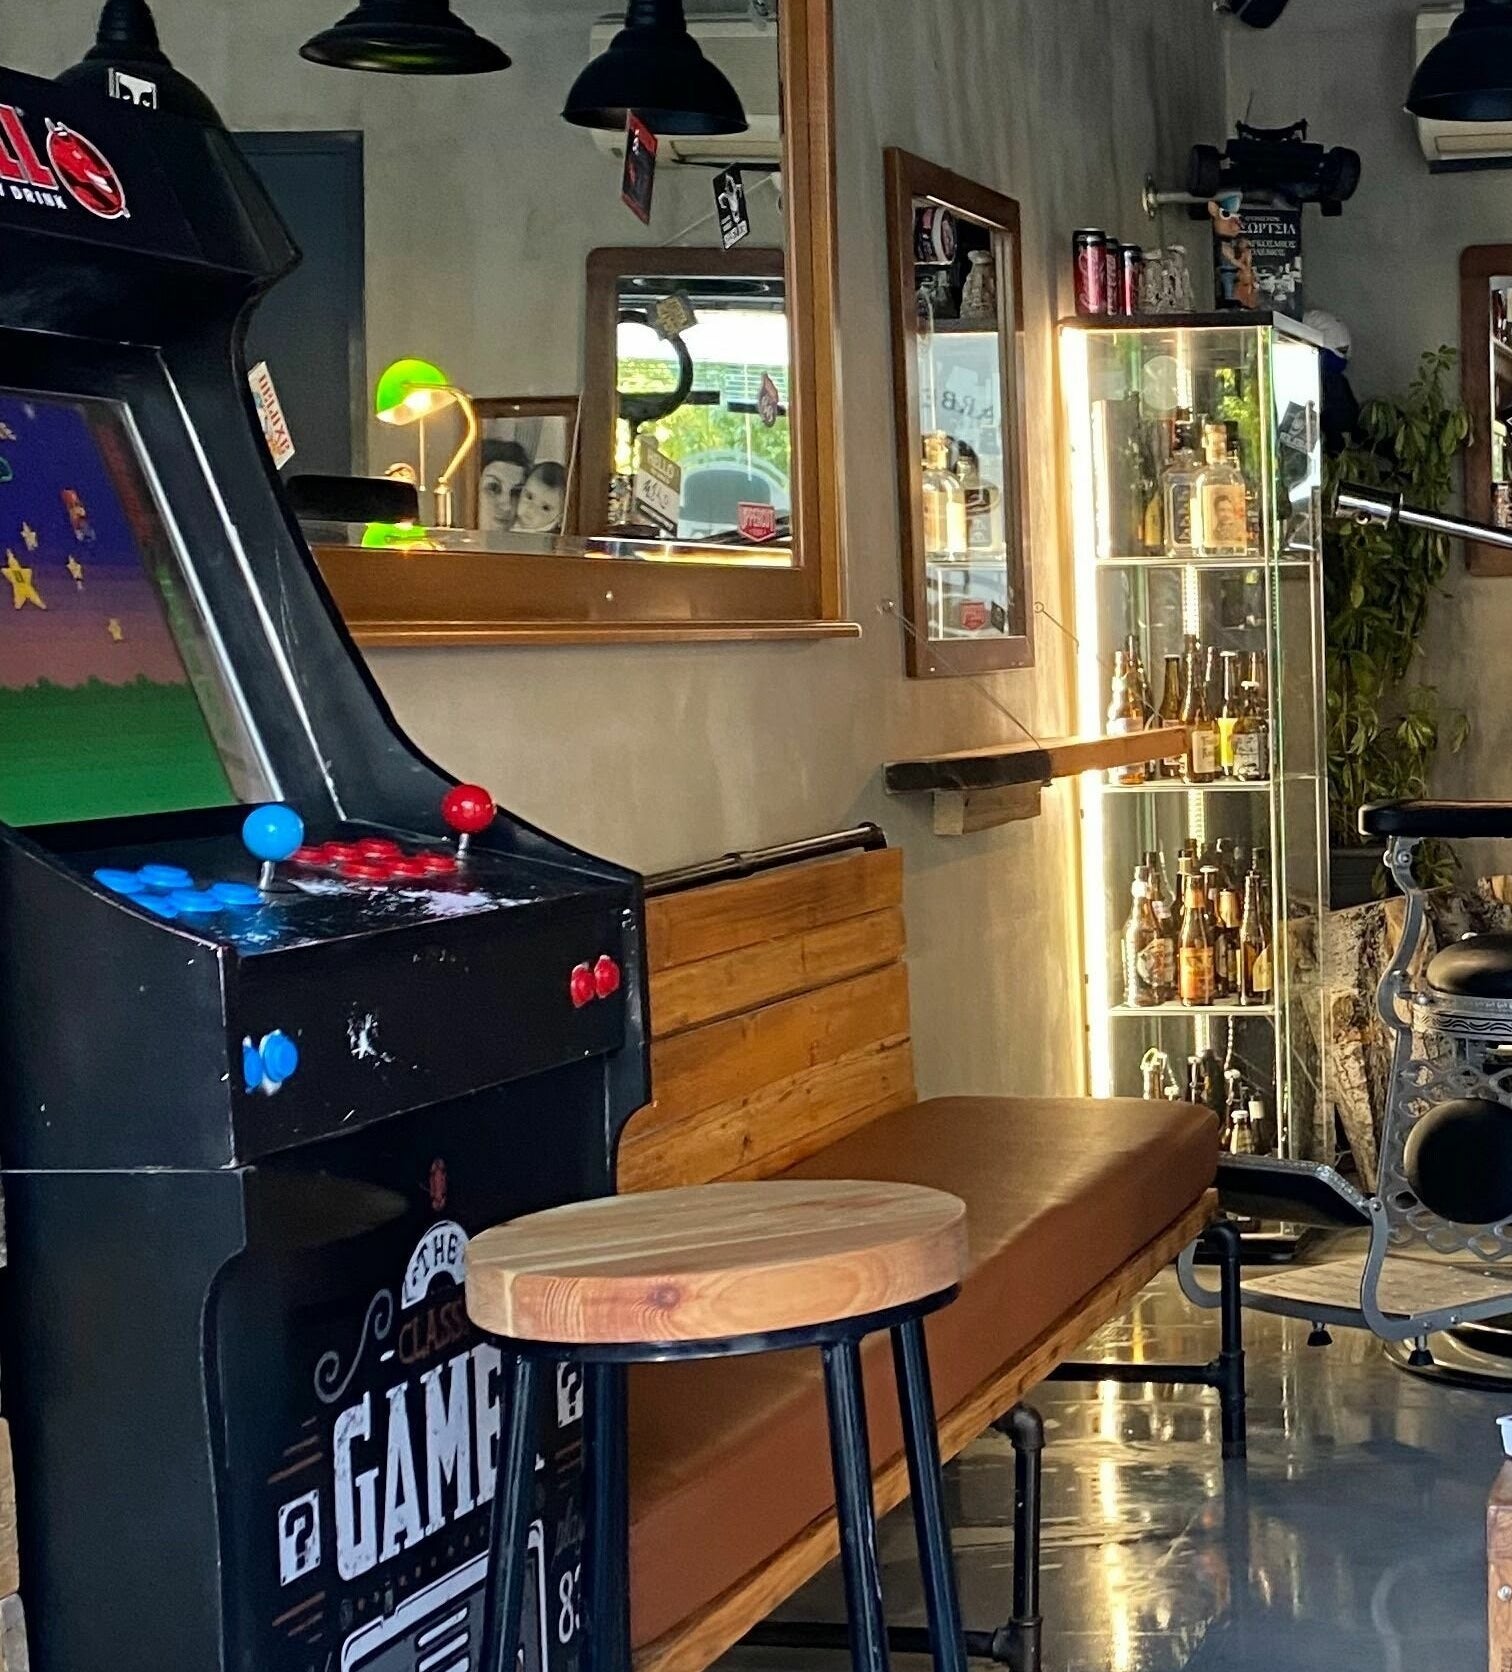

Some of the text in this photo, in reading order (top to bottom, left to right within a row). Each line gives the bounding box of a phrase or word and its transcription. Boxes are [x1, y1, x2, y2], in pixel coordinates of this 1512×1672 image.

[9, 185, 68, 209] DRINK
[417, 1232, 459, 1278] THE
[333, 1342, 501, 1581] GAME
